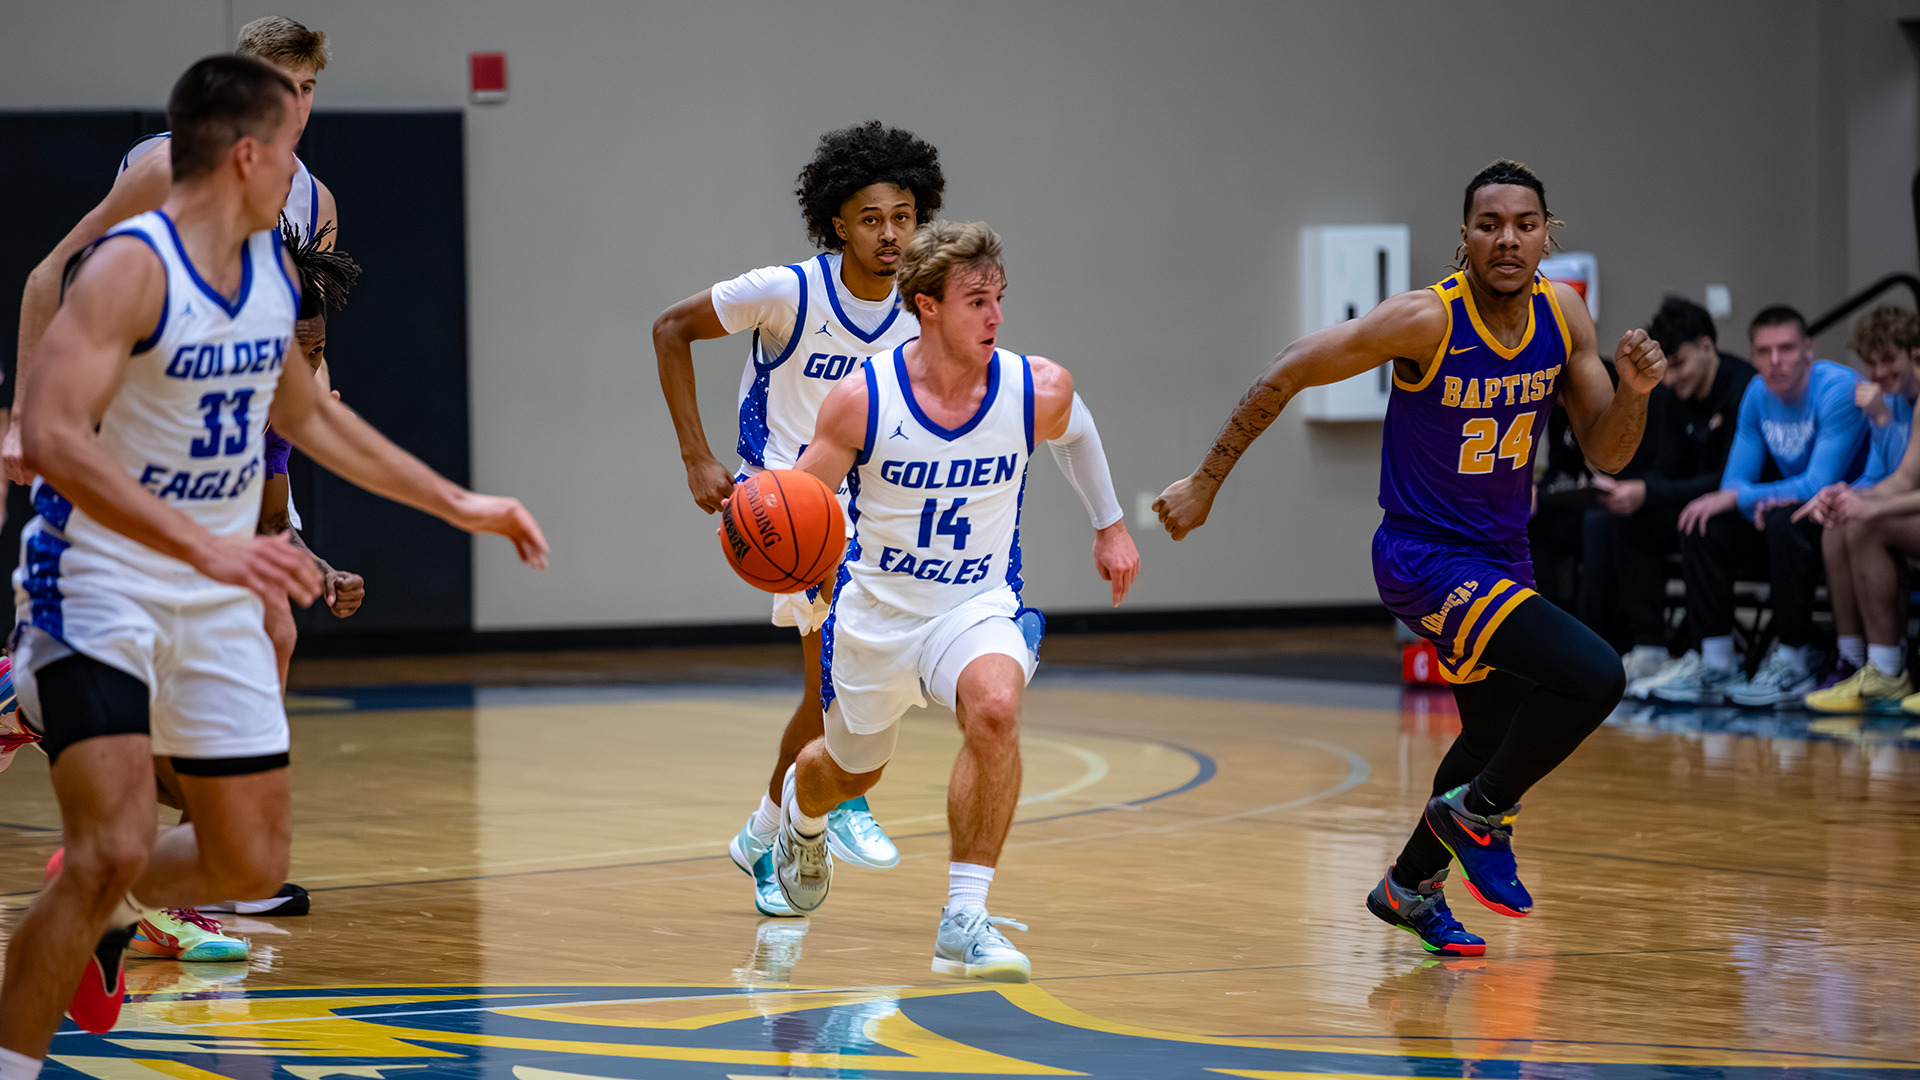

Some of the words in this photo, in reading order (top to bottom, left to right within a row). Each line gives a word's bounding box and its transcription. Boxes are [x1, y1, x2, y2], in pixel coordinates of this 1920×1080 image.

[165, 335, 290, 380] GOLDEN
[803, 352, 872, 381] GOL
[1441, 364, 1561, 408] BAPTIST
[190, 388, 255, 459] 33
[1457, 411, 1537, 474] 24
[880, 452, 1018, 489] GOLDEN
[917, 497, 971, 550] 14
[879, 546, 993, 585] EAGLES
